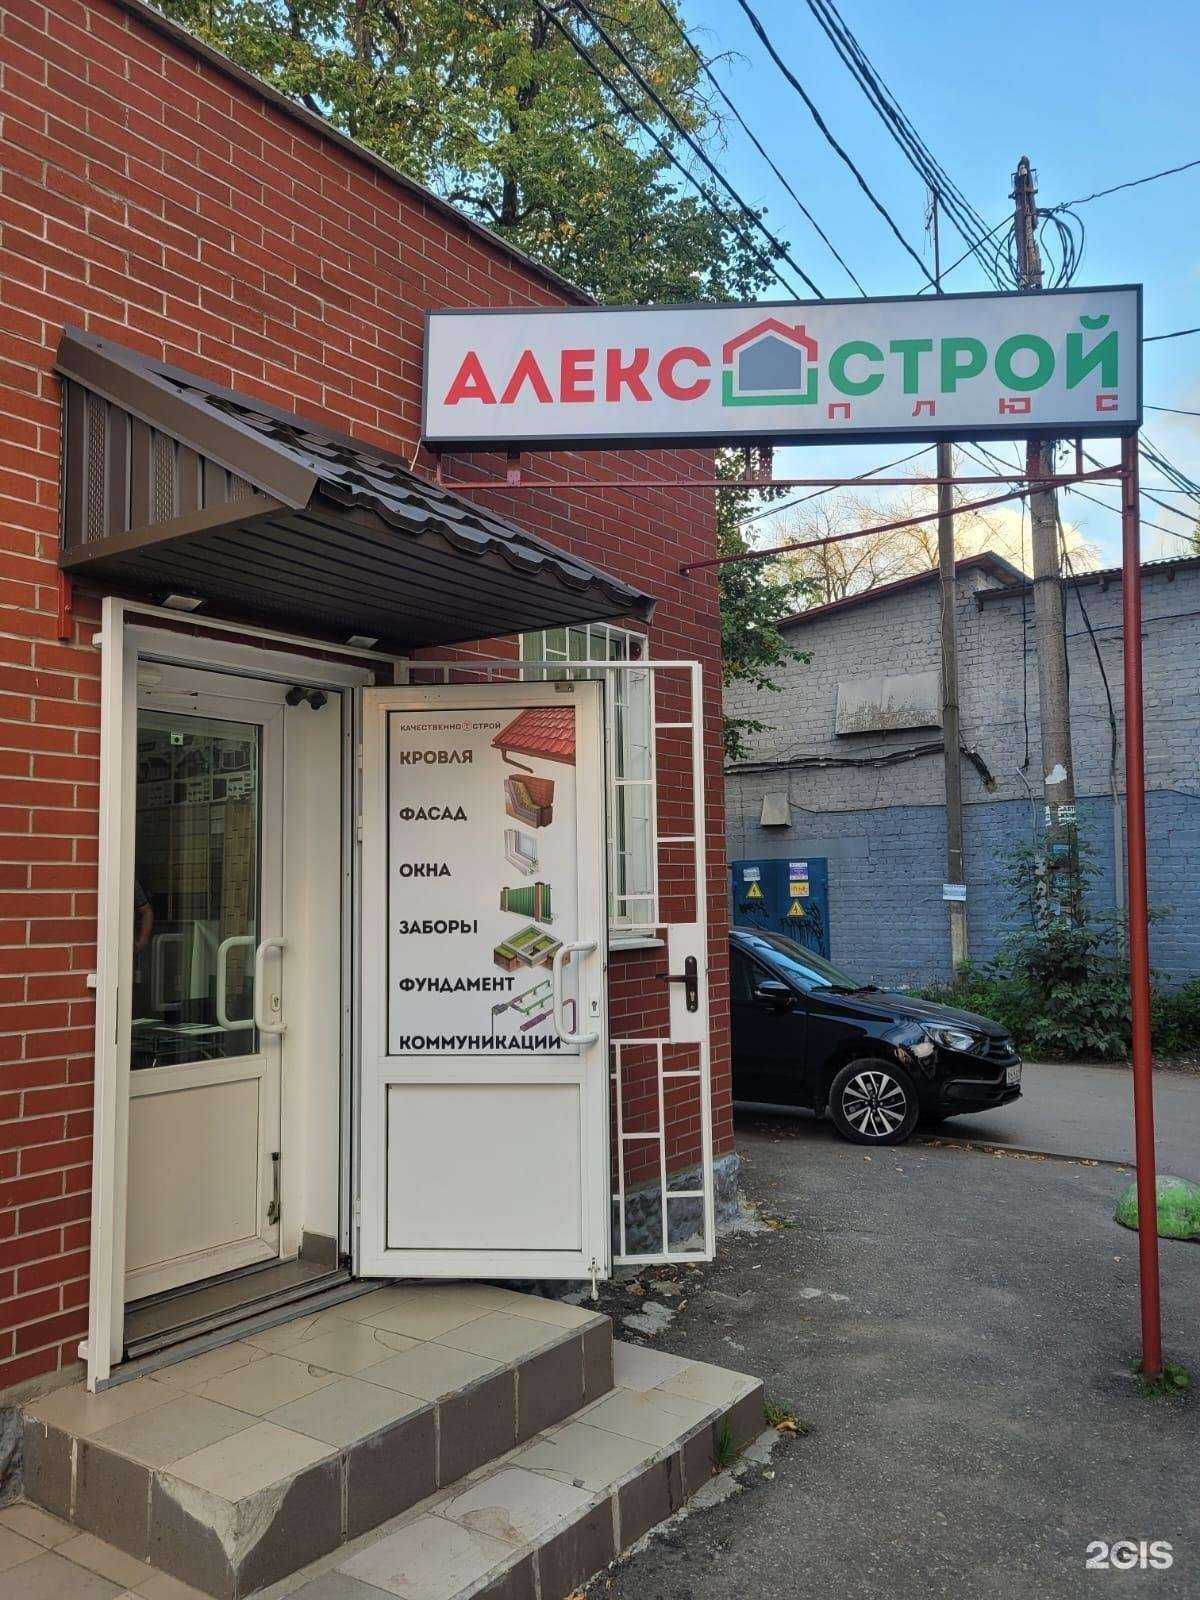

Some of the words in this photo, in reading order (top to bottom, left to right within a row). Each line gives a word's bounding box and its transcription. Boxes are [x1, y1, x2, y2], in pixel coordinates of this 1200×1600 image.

[443, 346, 712, 405] АЛЕКС
[828, 314, 1119, 396] СТРОЙ
[828, 394, 1119, 419] ПЛЮС
[400, 723, 461, 732] КАЧЕСТВЕННО
[400, 750, 473, 765] КРОВЛЯ
[399, 806, 468, 821] ФАСАД
[399, 863, 451, 878] ОКНА
[399, 920, 478, 934] ЗАБОРЫ
[399, 977, 515, 992] ФУНДАМЕНТ
[399, 1035, 561, 1051] КОММУНИКАЦИИ
